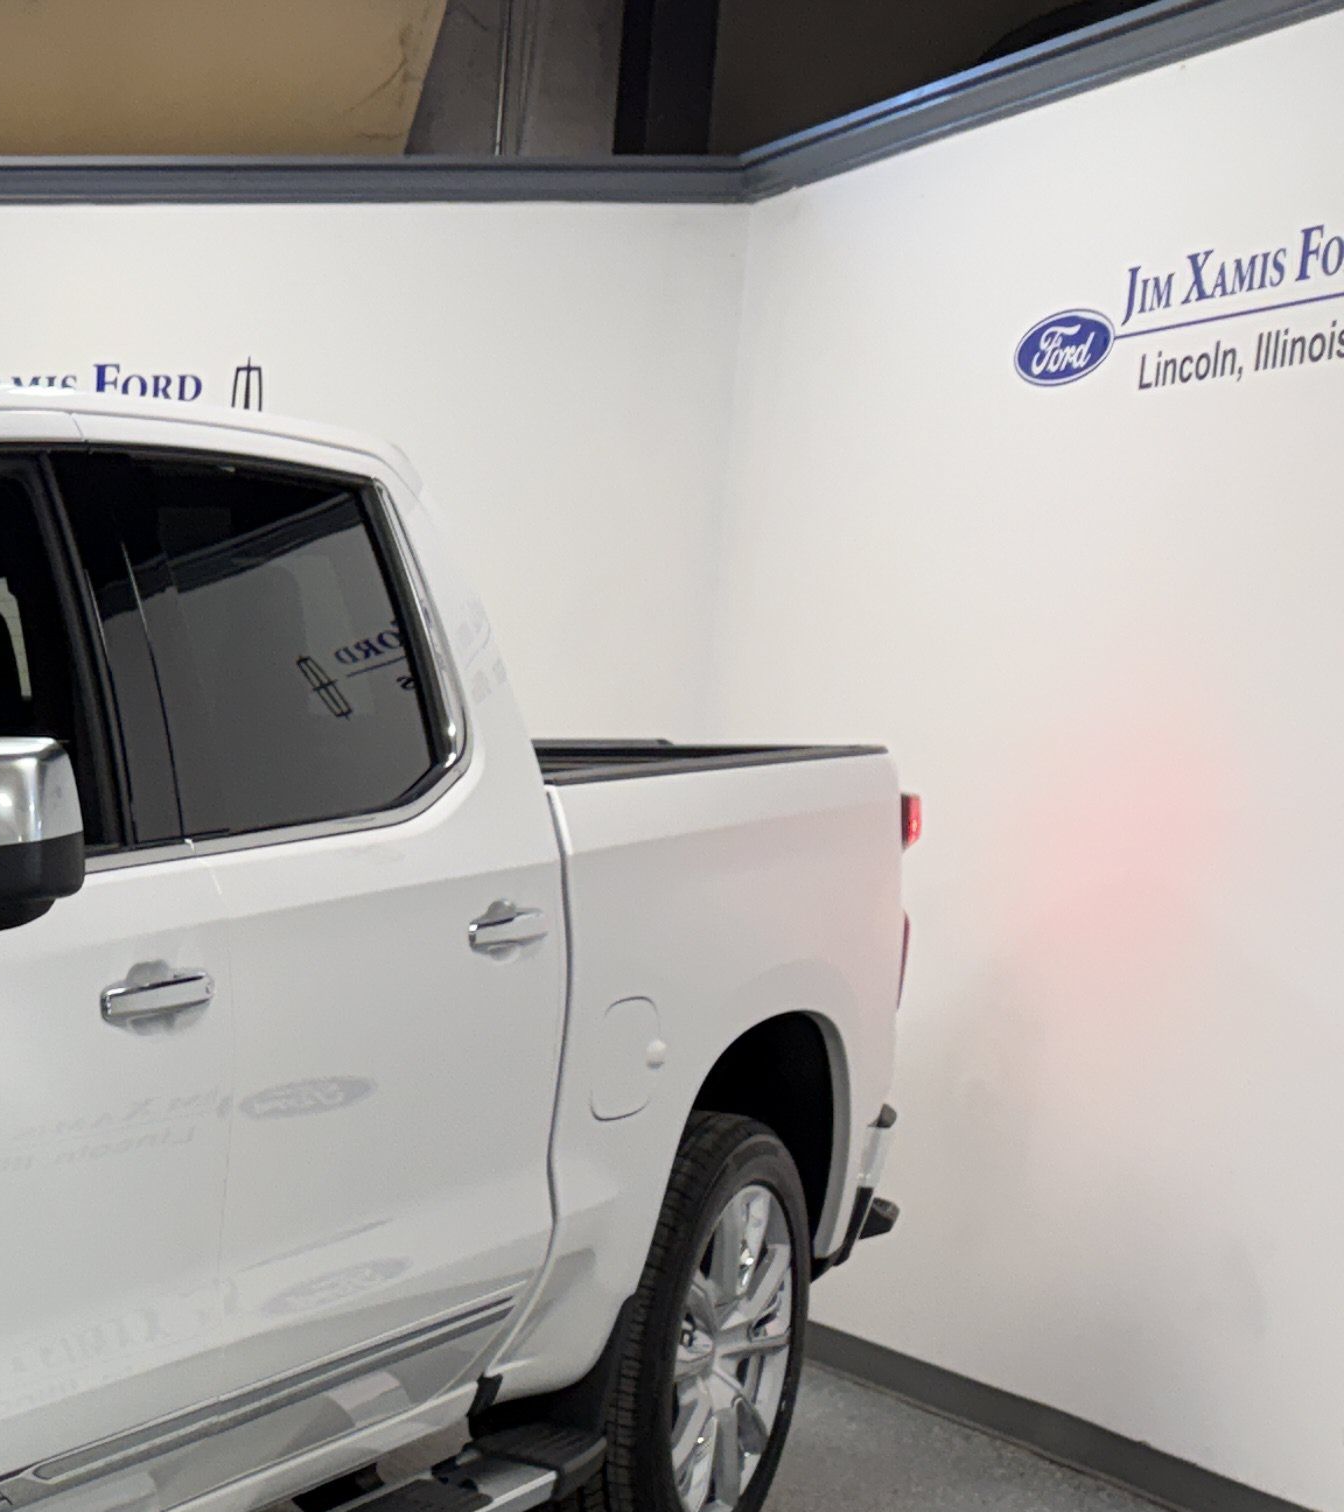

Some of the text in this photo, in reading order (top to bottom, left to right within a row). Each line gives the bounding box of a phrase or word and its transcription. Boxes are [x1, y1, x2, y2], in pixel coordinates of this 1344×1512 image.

[1121, 224, 1344, 327] JIM XAMIS FO
[1030, 323, 1095, 376] Ford
[1138, 319, 1344, 390] Lincoln, Illinois
[93, 363, 203, 401] FORD
